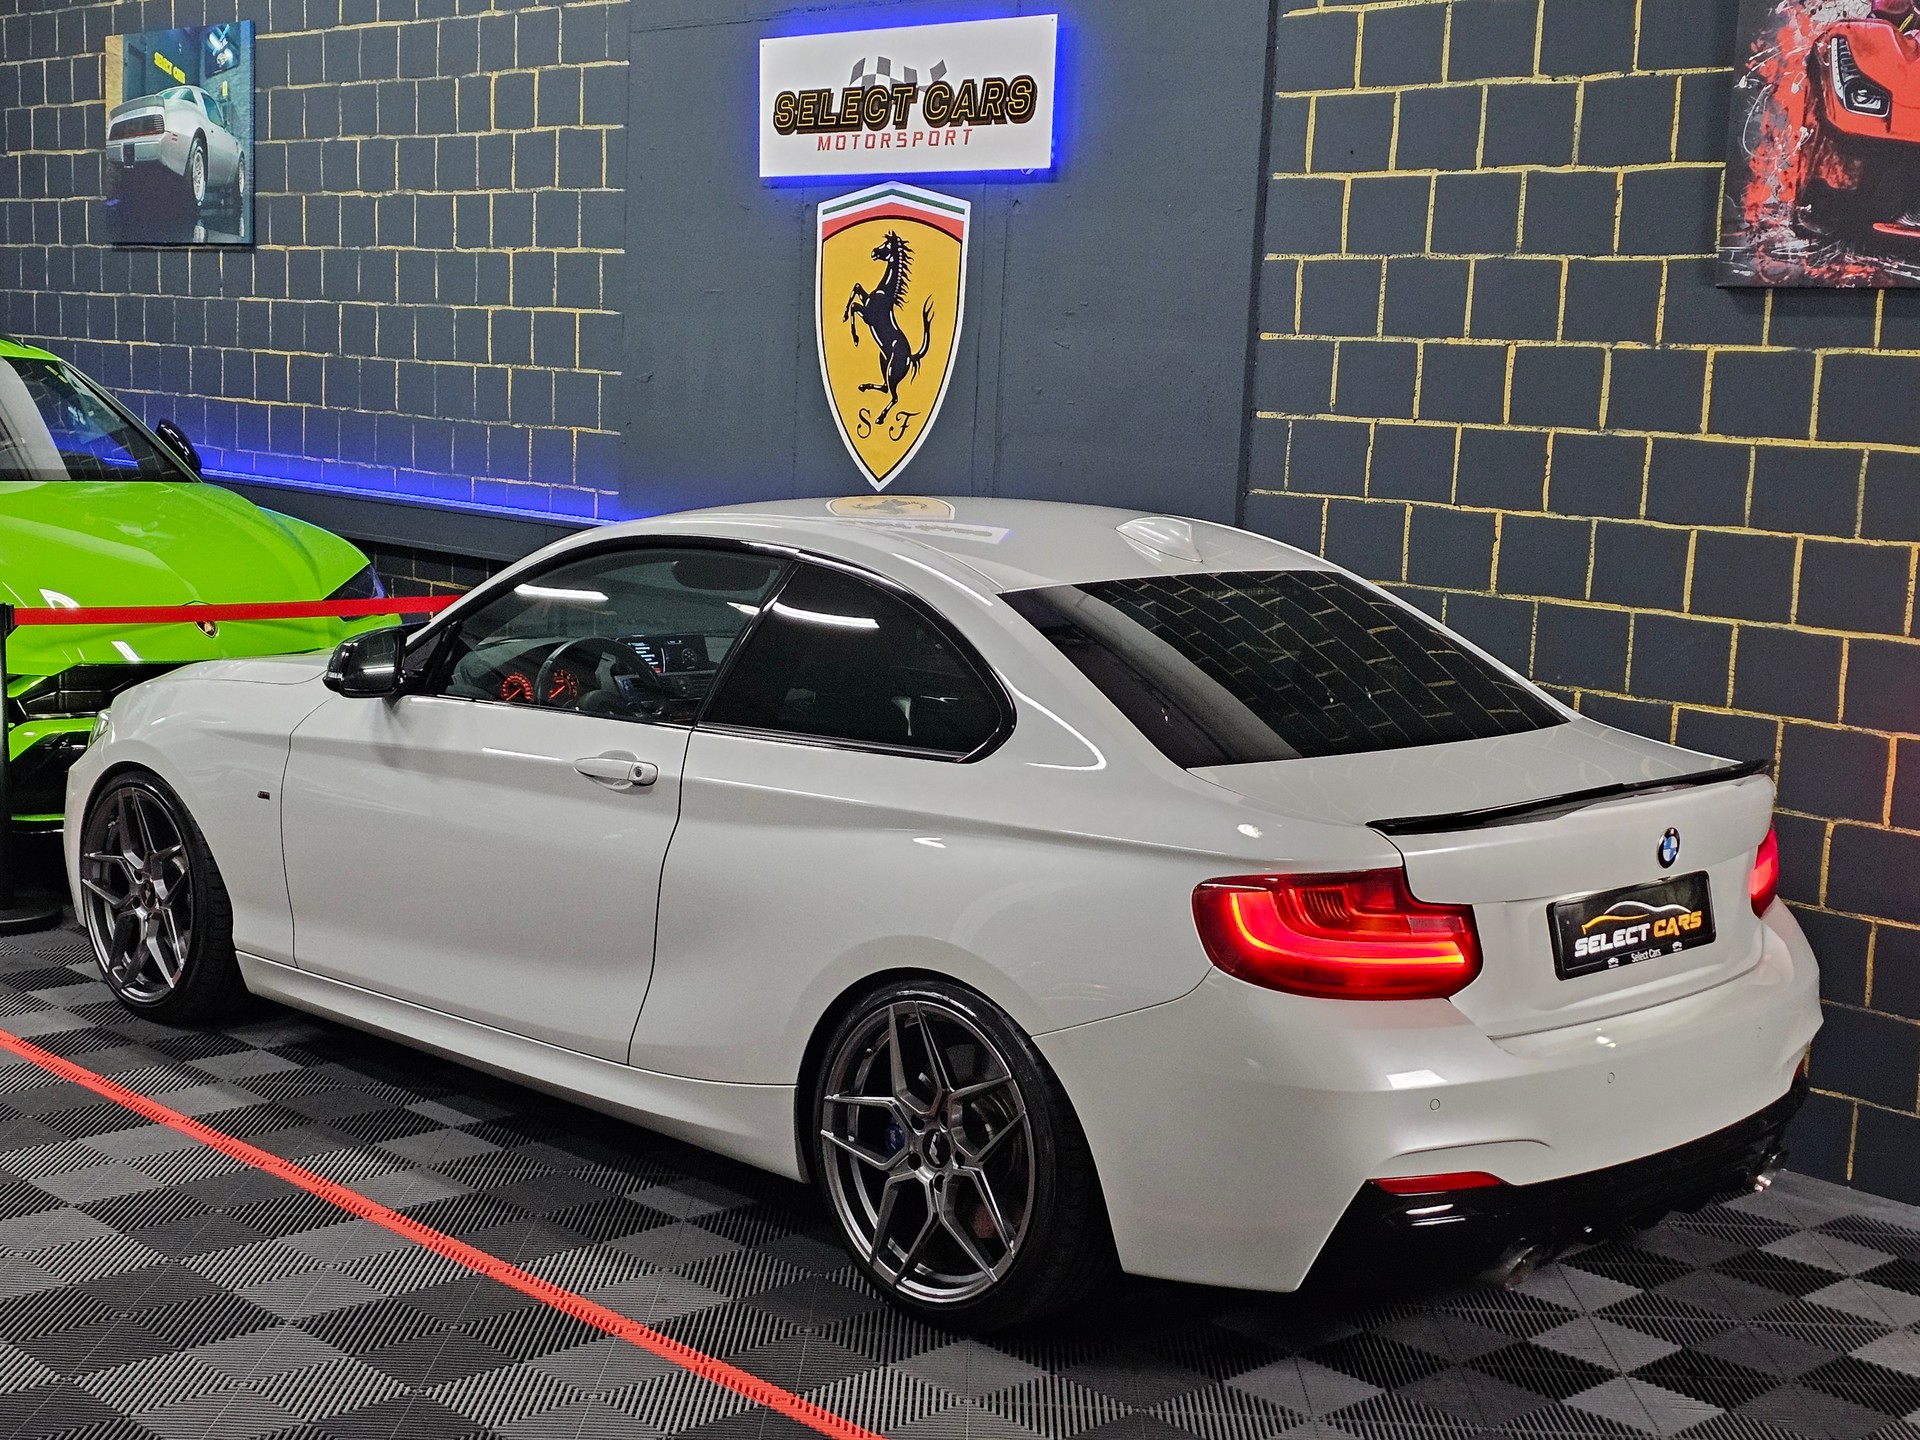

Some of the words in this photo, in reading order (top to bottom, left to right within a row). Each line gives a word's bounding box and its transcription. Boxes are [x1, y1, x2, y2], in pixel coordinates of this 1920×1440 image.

[773, 81, 917, 135] SELECT
[923, 75, 1038, 128] CARS
[817, 129, 973, 151] MOTORSPORT
[856, 408, 872, 439] S
[889, 411, 921, 441] F
[1574, 923, 1650, 957] SELECT
[1653, 910, 1702, 937] CARS
[1631, 951, 1649, 963] Select
[1649, 948, 1662, 958] Cars
